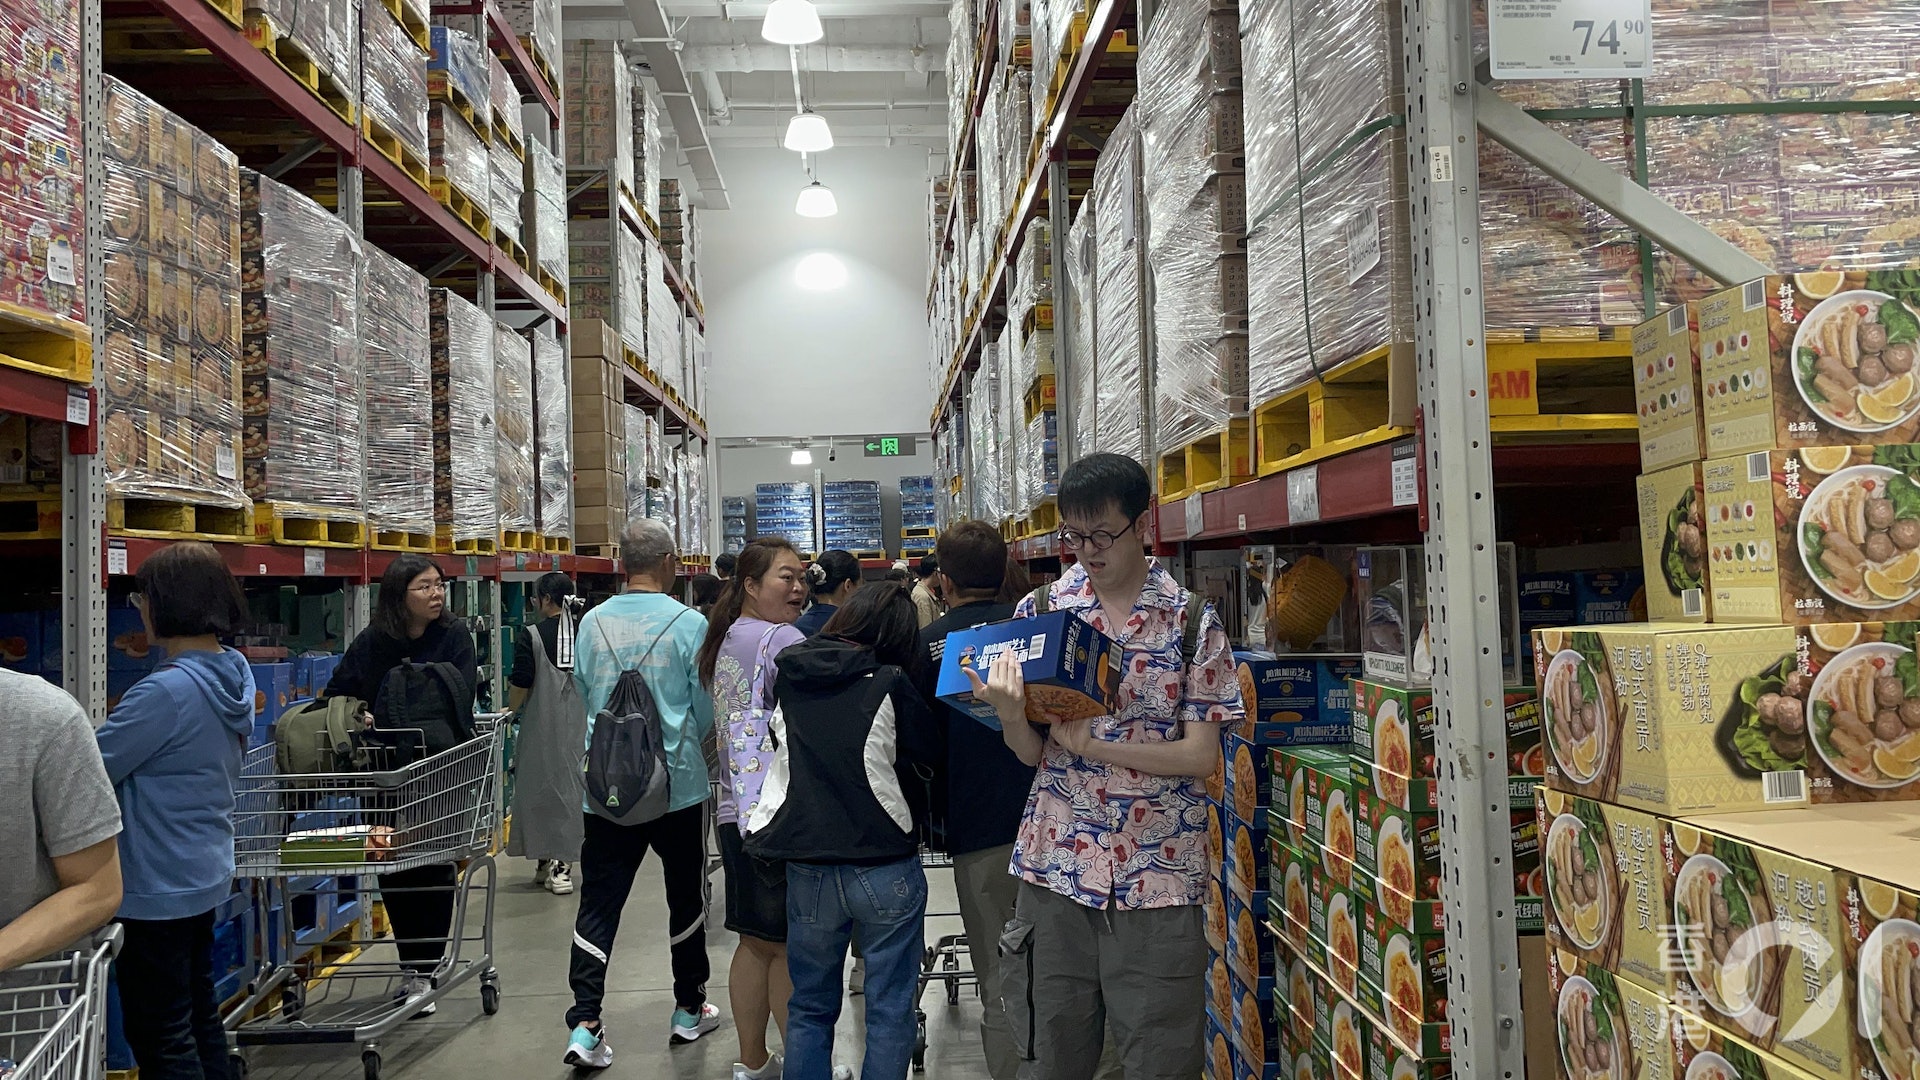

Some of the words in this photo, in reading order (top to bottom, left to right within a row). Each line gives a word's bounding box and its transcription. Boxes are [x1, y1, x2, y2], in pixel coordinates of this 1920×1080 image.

[1613, 646, 1629, 697] 河粉
[1629, 646, 1651, 753] 越式西贡
[1677, 643, 1695, 711] 弹牙有嚼劲
[1694, 643, 1714, 724] Q弹牛筋肉丸
[1615, 820, 1630, 873] 河粉
[1630, 825, 1652, 934] 越式西贡
[1771, 868, 1794, 933] 河粉
[1794, 878, 1822, 1009] 越式西贡
[1629, 998, 1644, 1050] 河粉
